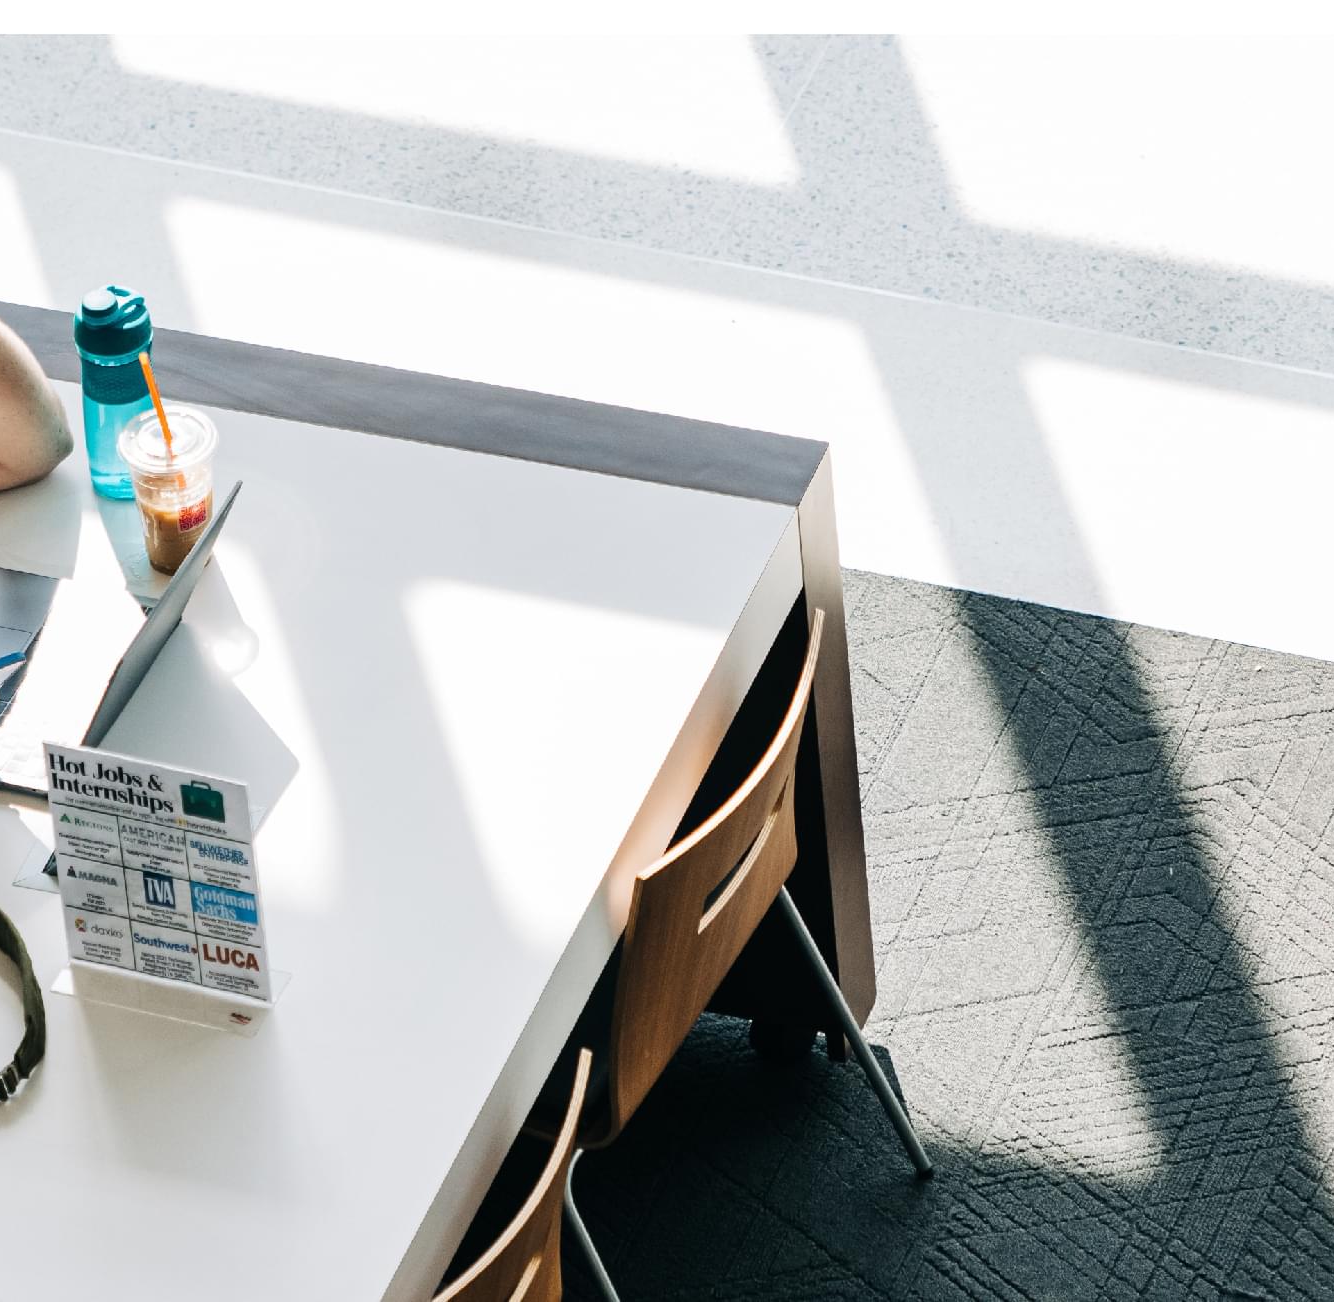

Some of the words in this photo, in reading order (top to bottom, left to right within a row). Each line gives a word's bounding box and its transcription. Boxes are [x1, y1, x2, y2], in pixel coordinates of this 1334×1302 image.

[49, 753, 87, 776] Hot
[93, 763, 142, 787] Jobs
[148, 774, 163, 792] &
[52, 772, 173, 814] Internships
[121, 824, 185, 846] AMERICAN
[144, 877, 175, 905] TVA
[194, 886, 255, 911] Goldman
[196, 900, 237, 920] Sachs
[133, 932, 191, 953] Southwest
[202, 943, 260, 972] LUCA
